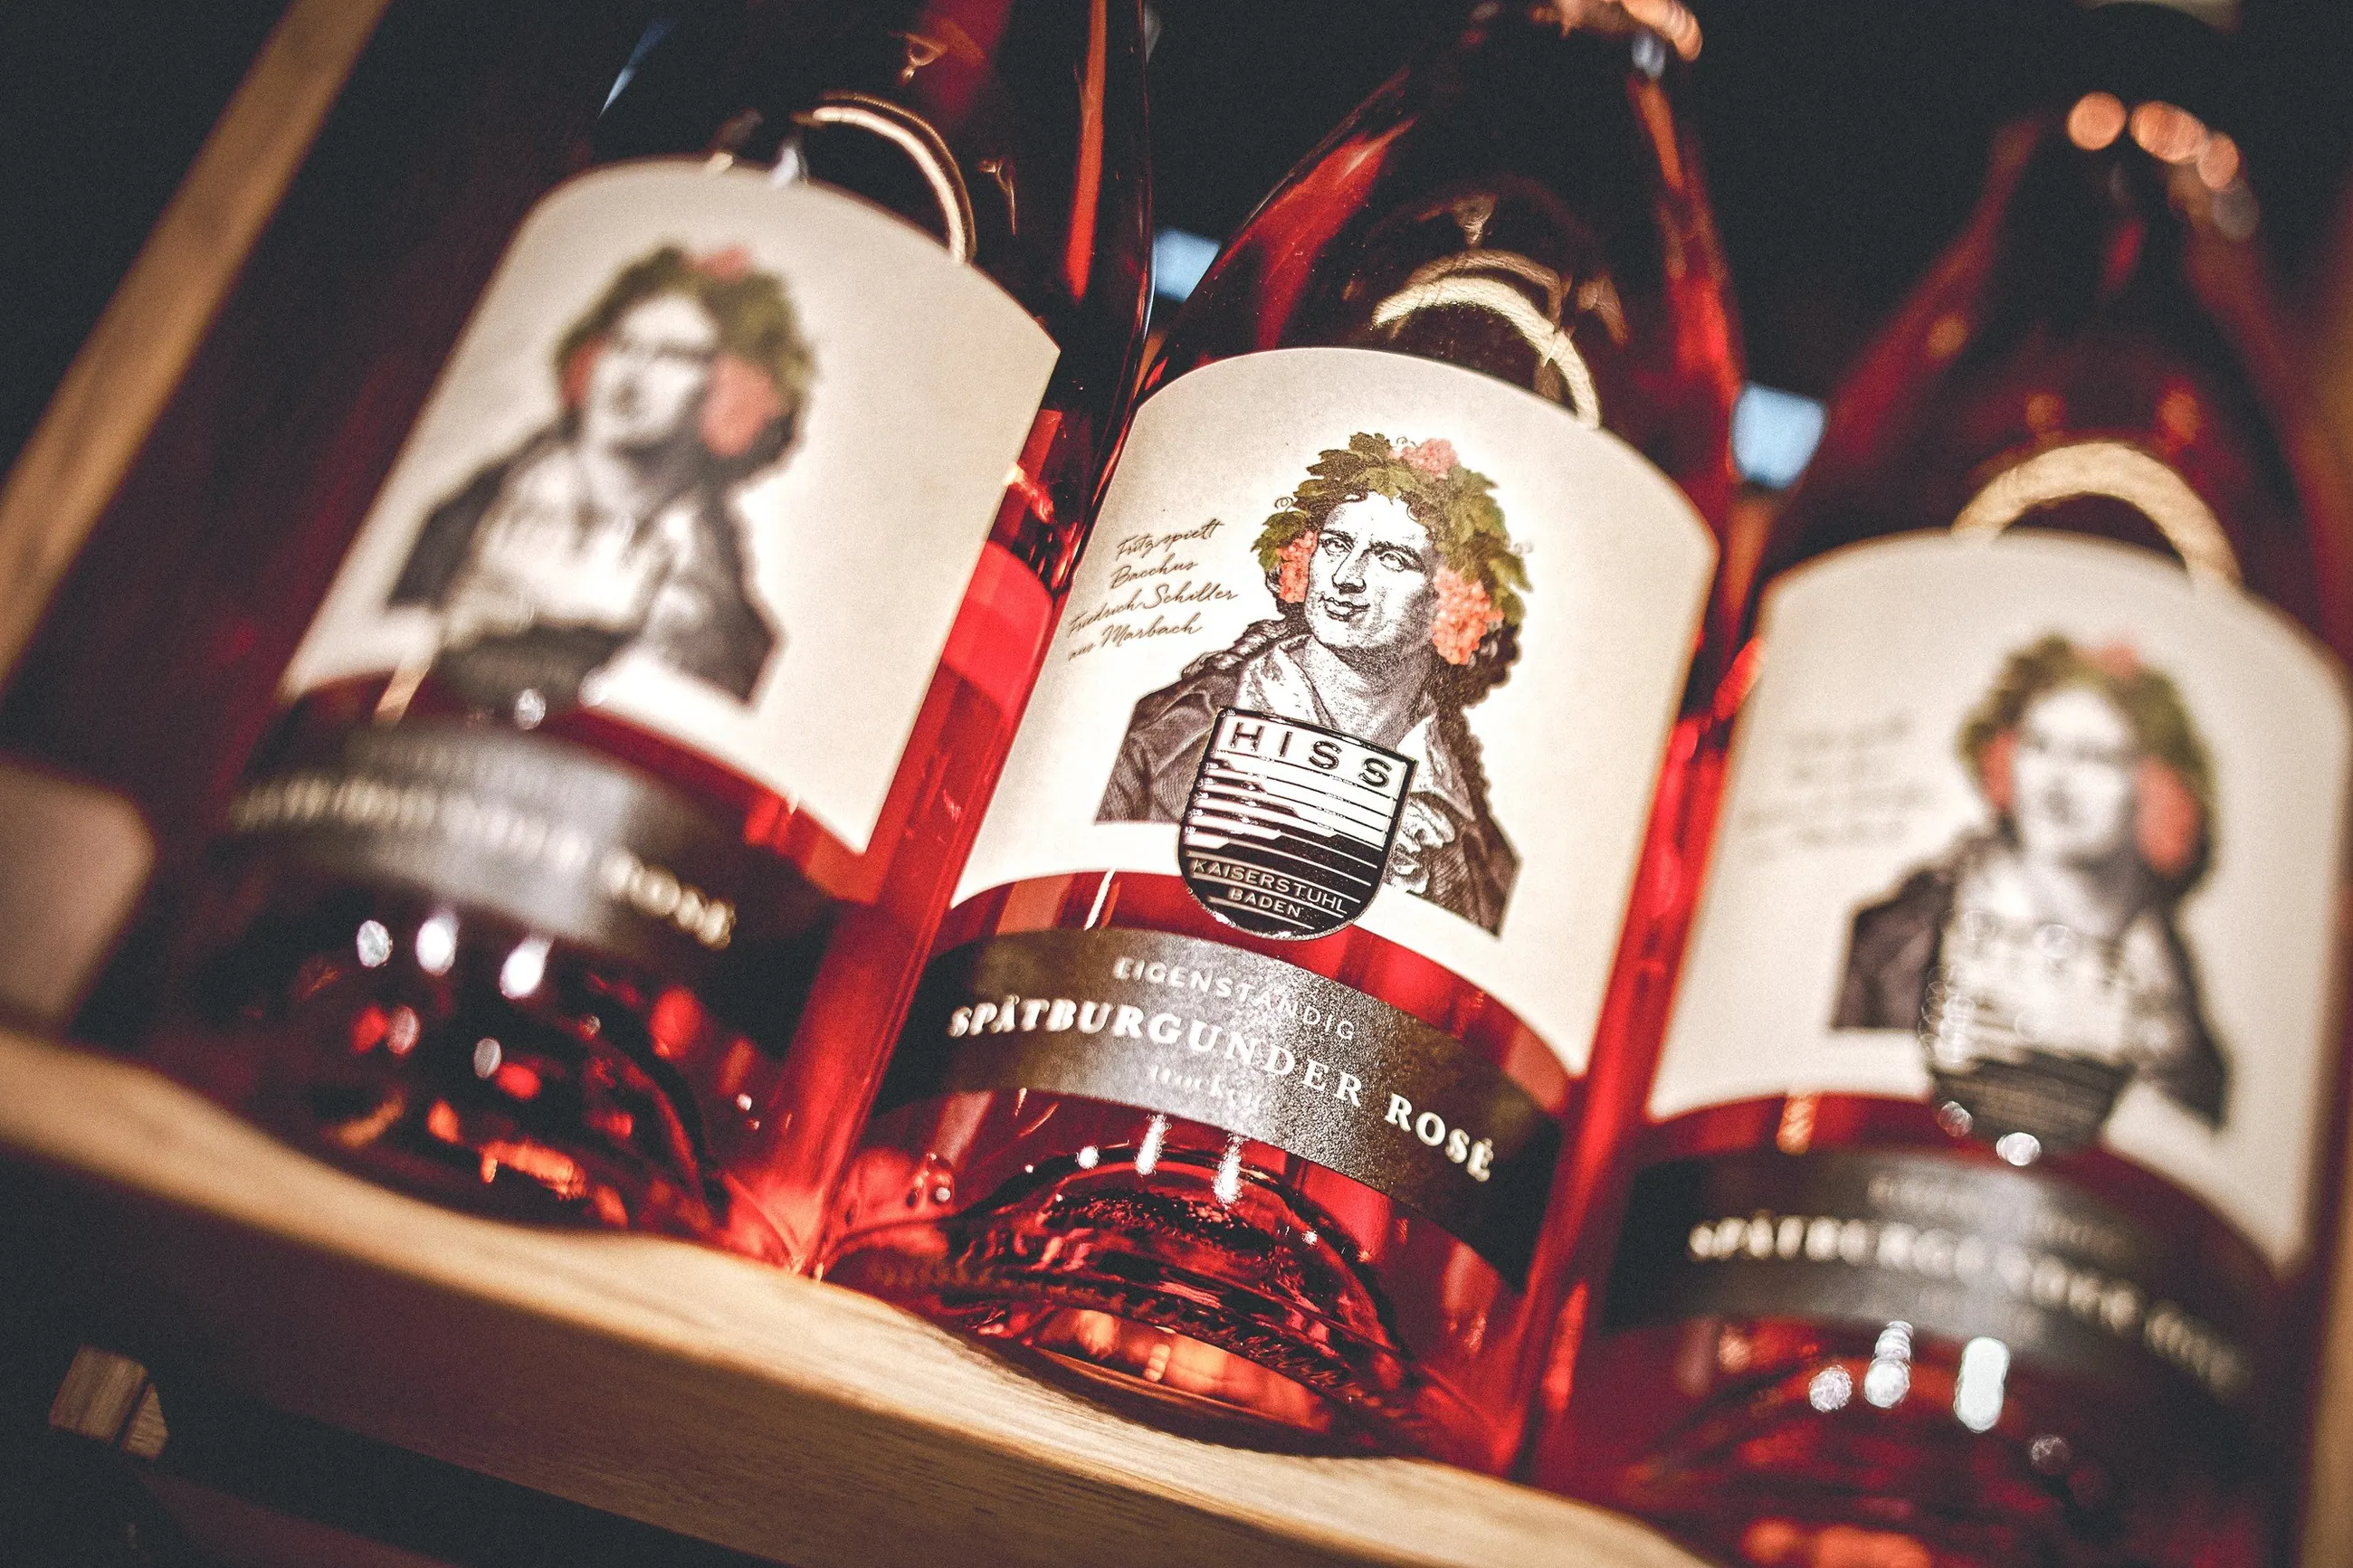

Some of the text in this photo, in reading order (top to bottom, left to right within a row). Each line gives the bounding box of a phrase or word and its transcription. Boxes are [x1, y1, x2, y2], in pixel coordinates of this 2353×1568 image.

[1110, 553, 1199, 589] Bacchus
[1144, 581, 1239, 610] Schiller
[1100, 612, 1204, 648] Marbach
[1230, 721, 1394, 788] HISS
[1190, 858, 1348, 915] KAISERSTUHL
[1227, 888, 1302, 918] BADEN
[947, 994, 1364, 1109] SPÄTBURGUNDER
[1384, 1091, 1494, 1183] ROSÉ
